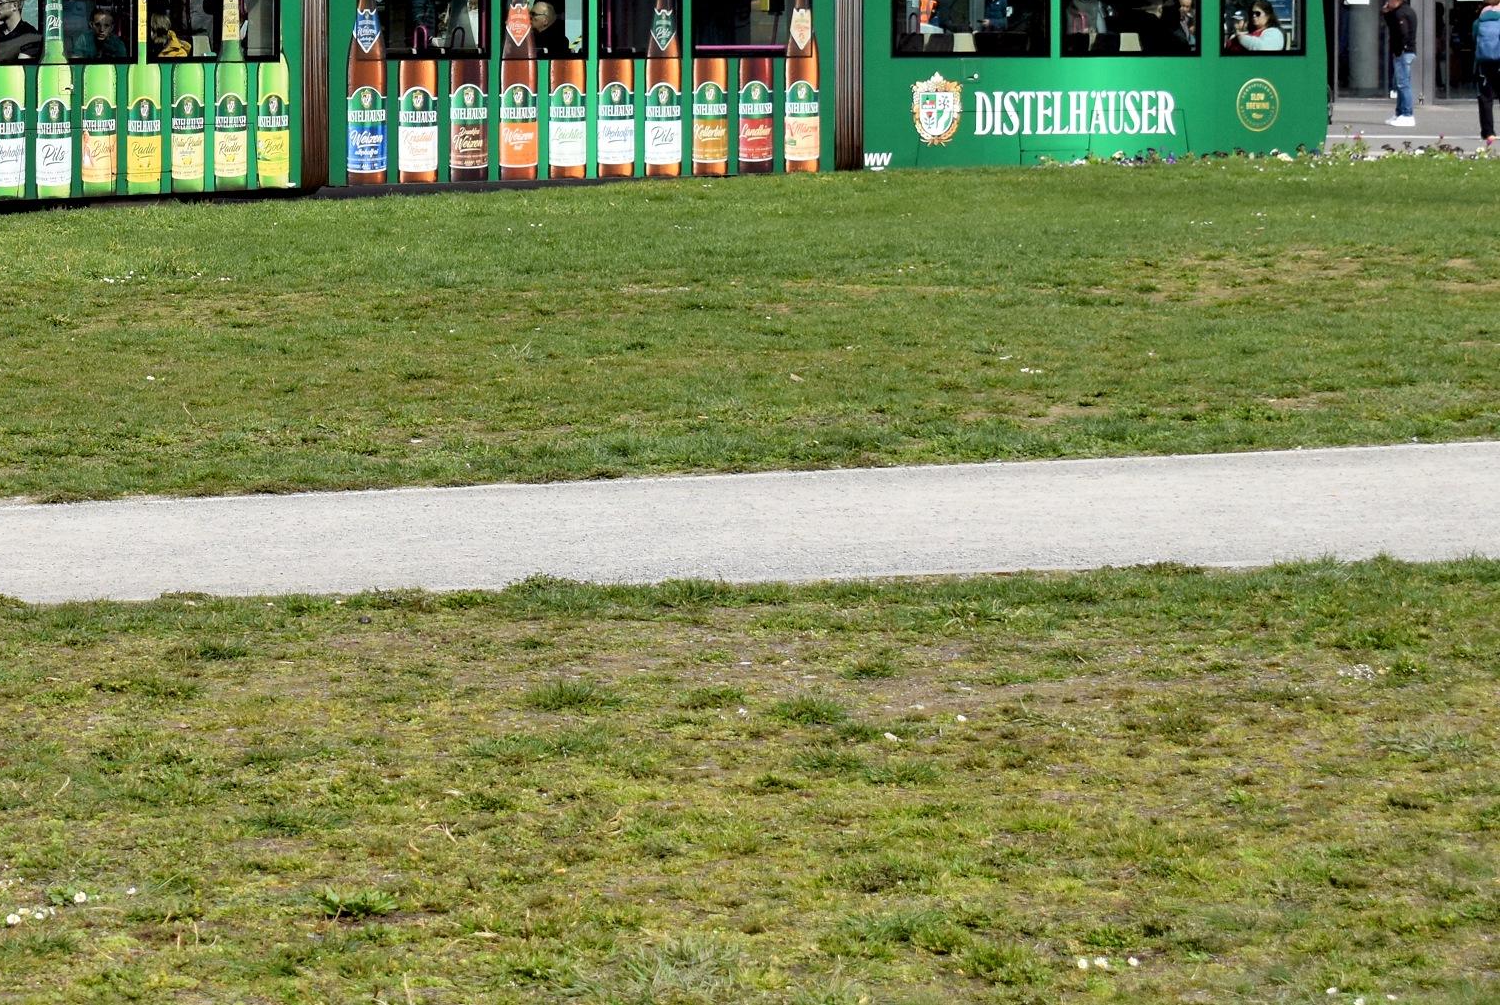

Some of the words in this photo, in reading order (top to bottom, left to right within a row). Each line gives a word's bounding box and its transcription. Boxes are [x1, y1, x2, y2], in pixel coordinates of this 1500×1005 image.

[973, 89, 1177, 136] DISTELHÄUSER
[350, 130, 383, 148] Weizen
[453, 134, 483, 152] Weizen
[651, 126, 675, 145] Pils
[41, 143, 67, 167] Pils
[131, 141, 158, 158] Radler
[218, 141, 242, 156] Radler
